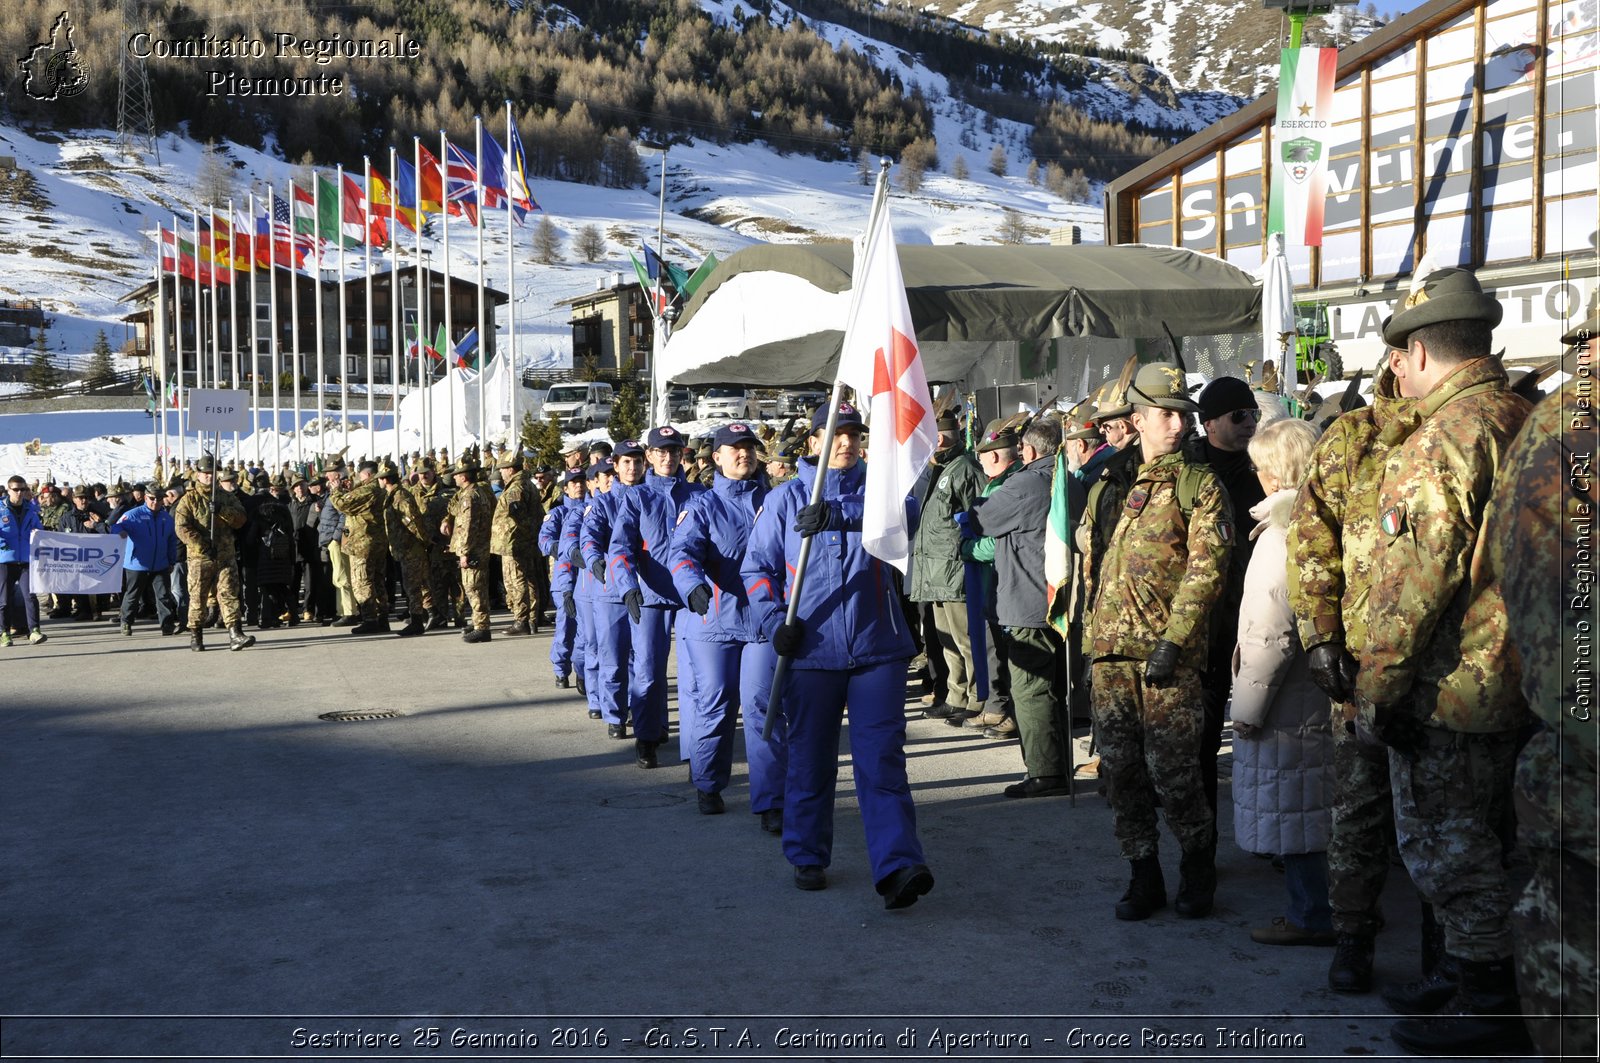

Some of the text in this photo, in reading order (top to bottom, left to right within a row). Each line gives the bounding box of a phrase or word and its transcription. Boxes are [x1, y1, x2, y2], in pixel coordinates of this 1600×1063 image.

[1281, 120, 1327, 129] ESERCITO
[1182, 114, 1574, 241] Snwtime.
[205, 406, 234, 414] FISIP
[34, 546, 103, 562] FISIP
